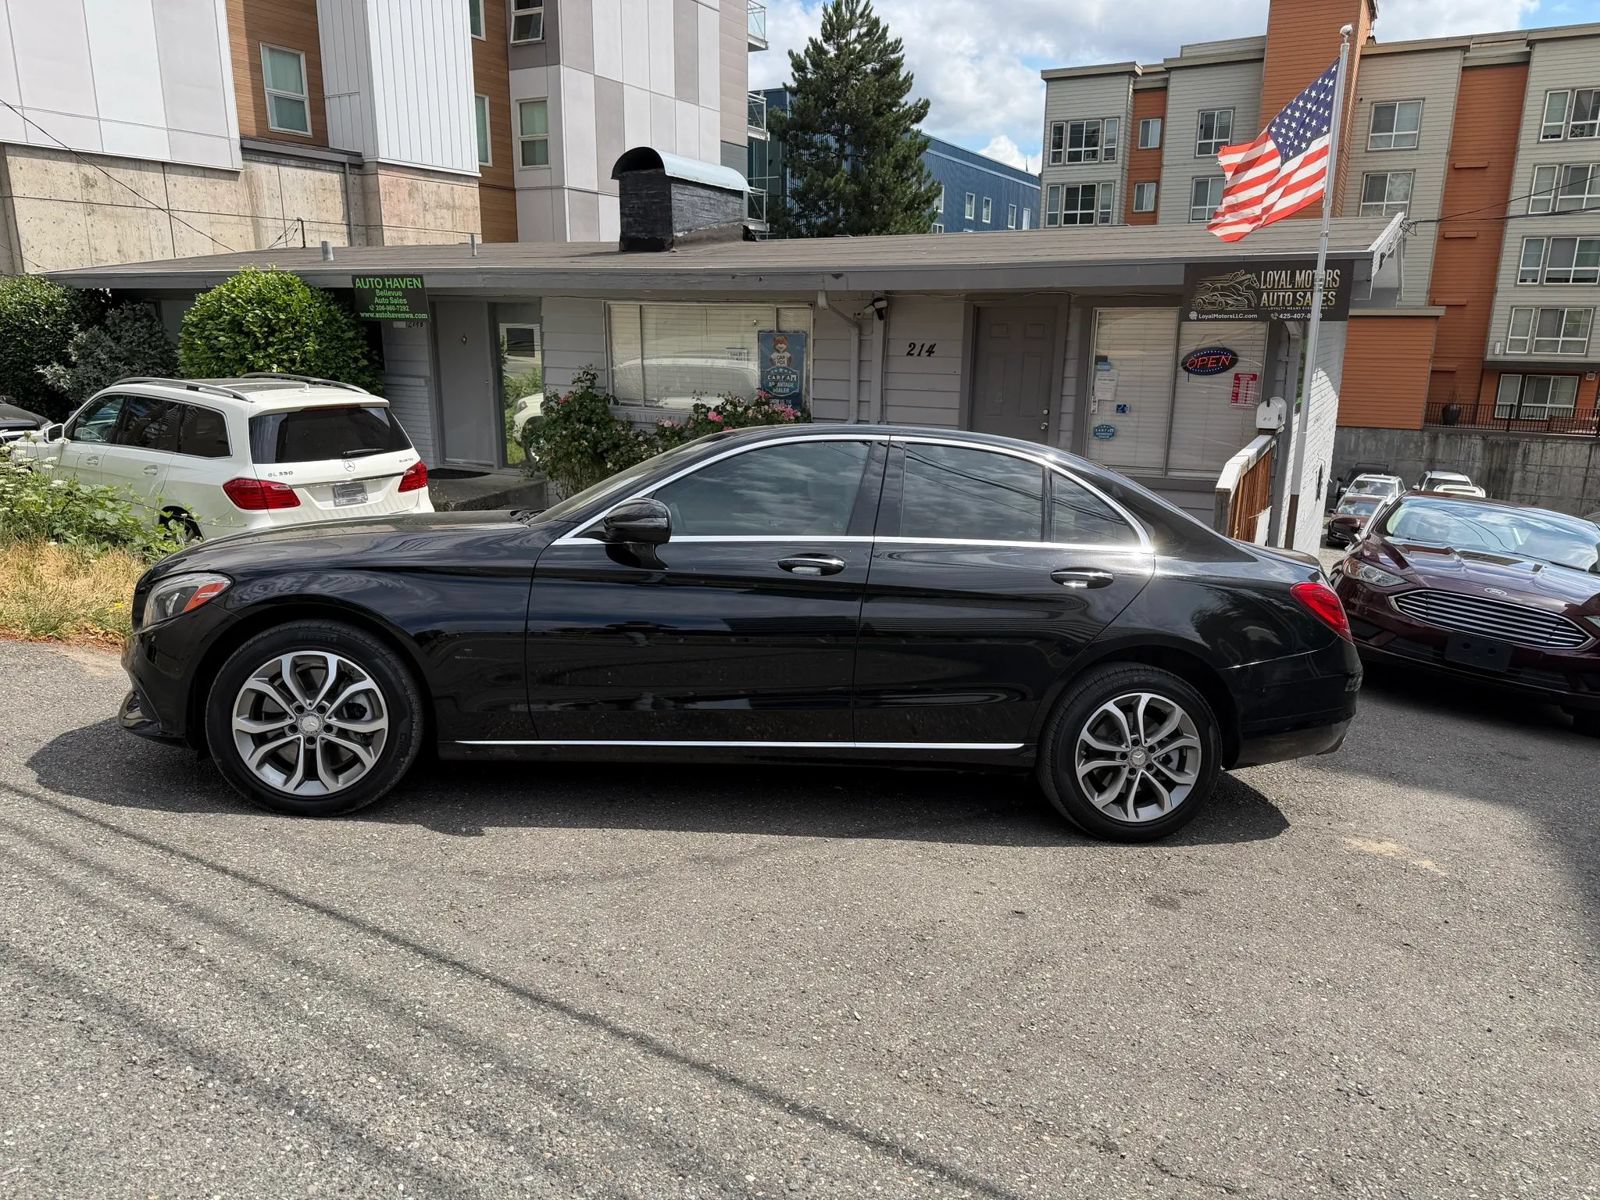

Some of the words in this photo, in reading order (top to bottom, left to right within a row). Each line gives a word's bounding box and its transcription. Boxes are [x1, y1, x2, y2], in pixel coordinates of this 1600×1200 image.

[355, 277, 383, 289] AUTO
[385, 277, 422, 289] HAVEN
[1260, 270, 1292, 289] LOYAL
[1294, 269, 1341, 289] MORS
[375, 289, 403, 297] Bellevue
[1260, 292, 1293, 307] AUTO
[1295, 291, 1337, 307] SAES
[906, 342, 937, 357] 214
[1187, 355, 1232, 369] OPEN
